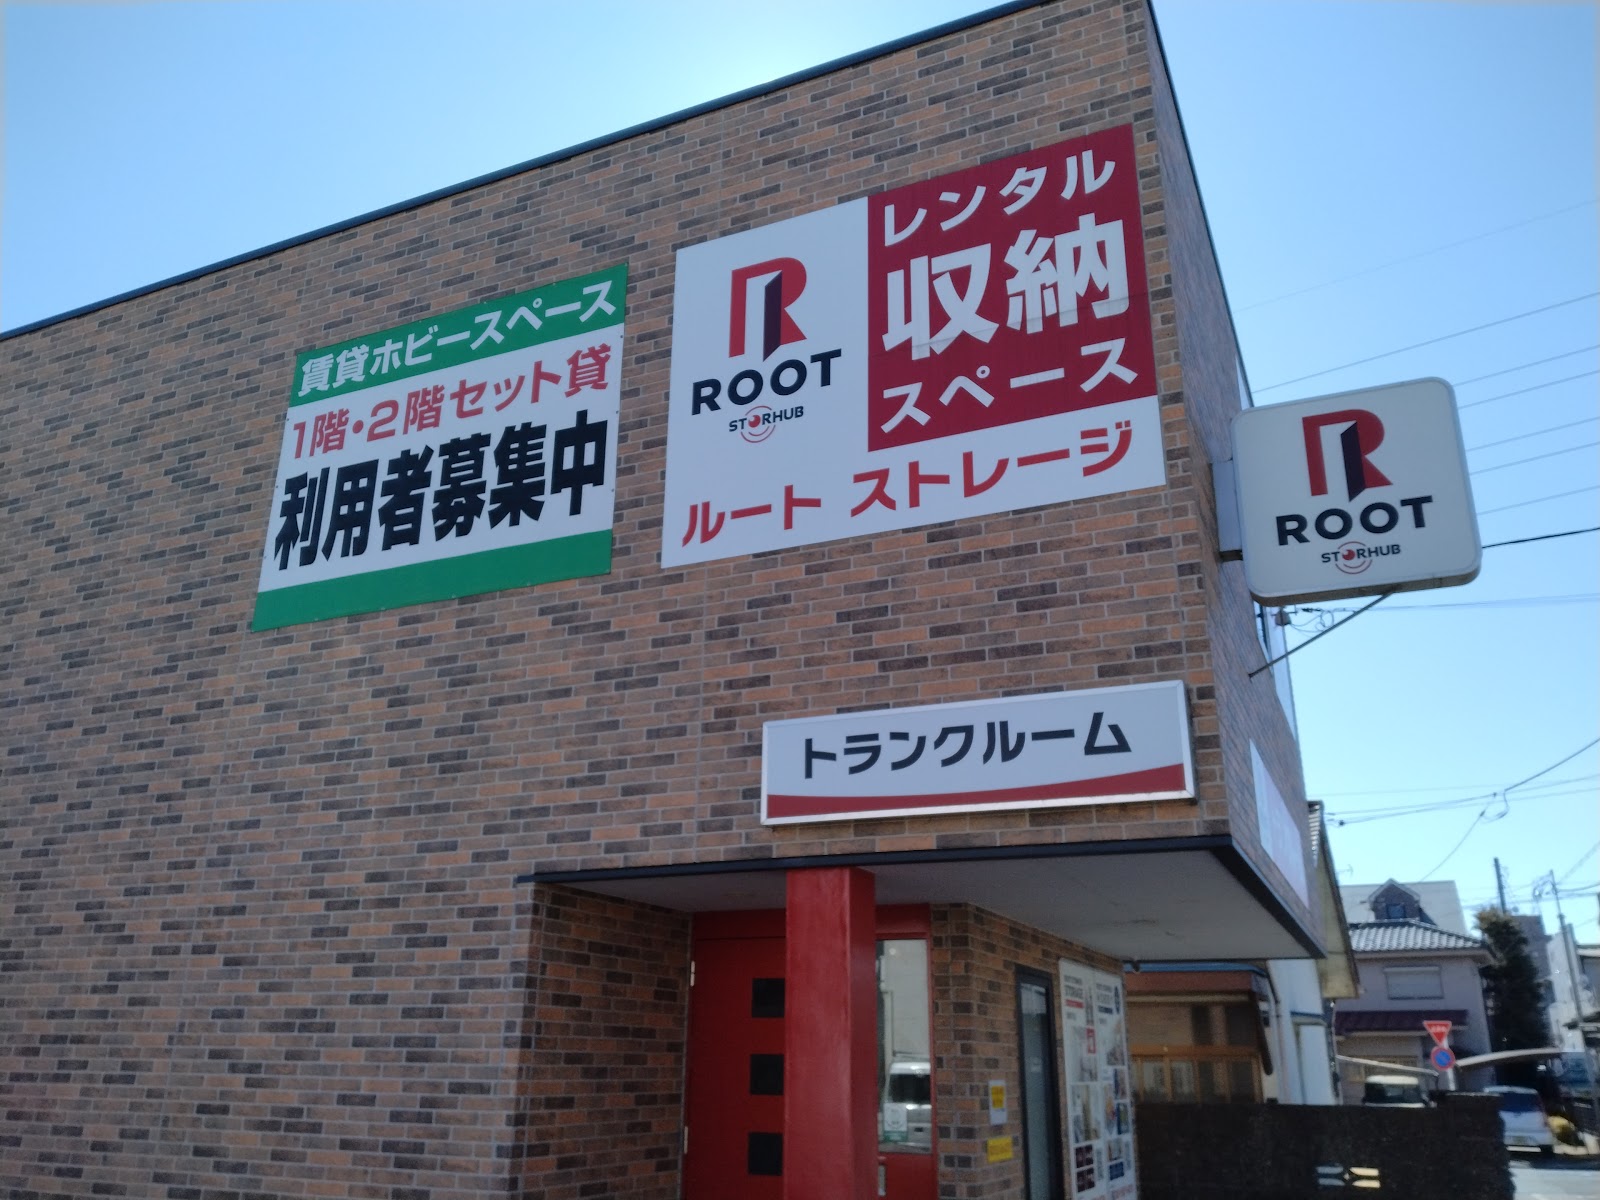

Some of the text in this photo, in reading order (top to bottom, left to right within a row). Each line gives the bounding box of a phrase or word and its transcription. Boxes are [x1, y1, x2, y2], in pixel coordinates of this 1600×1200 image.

[884, 149, 1116, 247] レンタル
[882, 212, 1130, 361] 収納
[297, 280, 616, 398] 賃貸ホビースペース
[690, 348, 842, 416] ROOT
[880, 337, 1139, 434] スペース
[274, 409, 608, 571] 利用者募集中
[682, 420, 1132, 547] ルート ストレージ
[1276, 495, 1433, 546] ROOT
[804, 711, 1132, 779] トランクルーム
